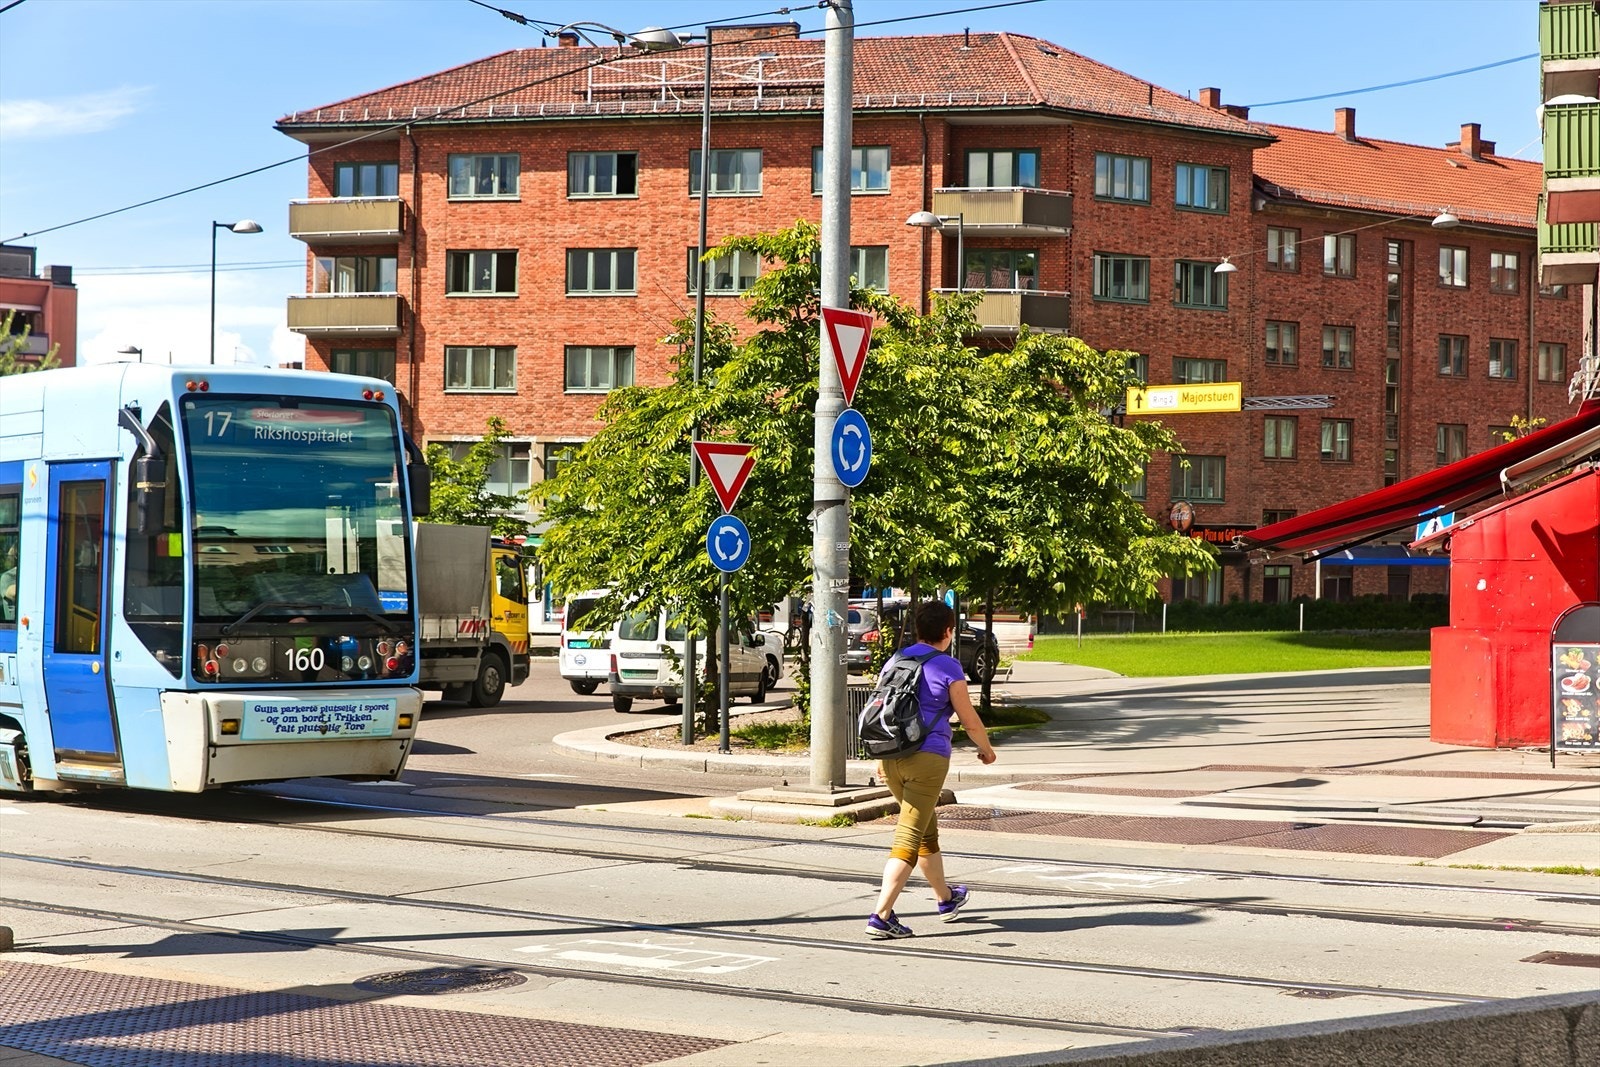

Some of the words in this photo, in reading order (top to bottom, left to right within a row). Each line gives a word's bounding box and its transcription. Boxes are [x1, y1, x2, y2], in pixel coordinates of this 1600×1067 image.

[1169, 395, 1174, 404] 2
[1182, 391, 1234, 405] Majorstuen
[204, 411, 232, 437] 17
[254, 425, 353, 444] Rikshospitalet
[285, 648, 325, 671] 160
[254, 705, 278, 713] Gulla
[281, 705, 318, 714] parkerte
[320, 704, 357, 714] plutselig
[364, 703, 389, 713] sporet
[282, 715, 298, 723] om
[327, 714, 331, 722] i
[275, 724, 295, 733] falt
[344, 722, 365, 731] Tore
